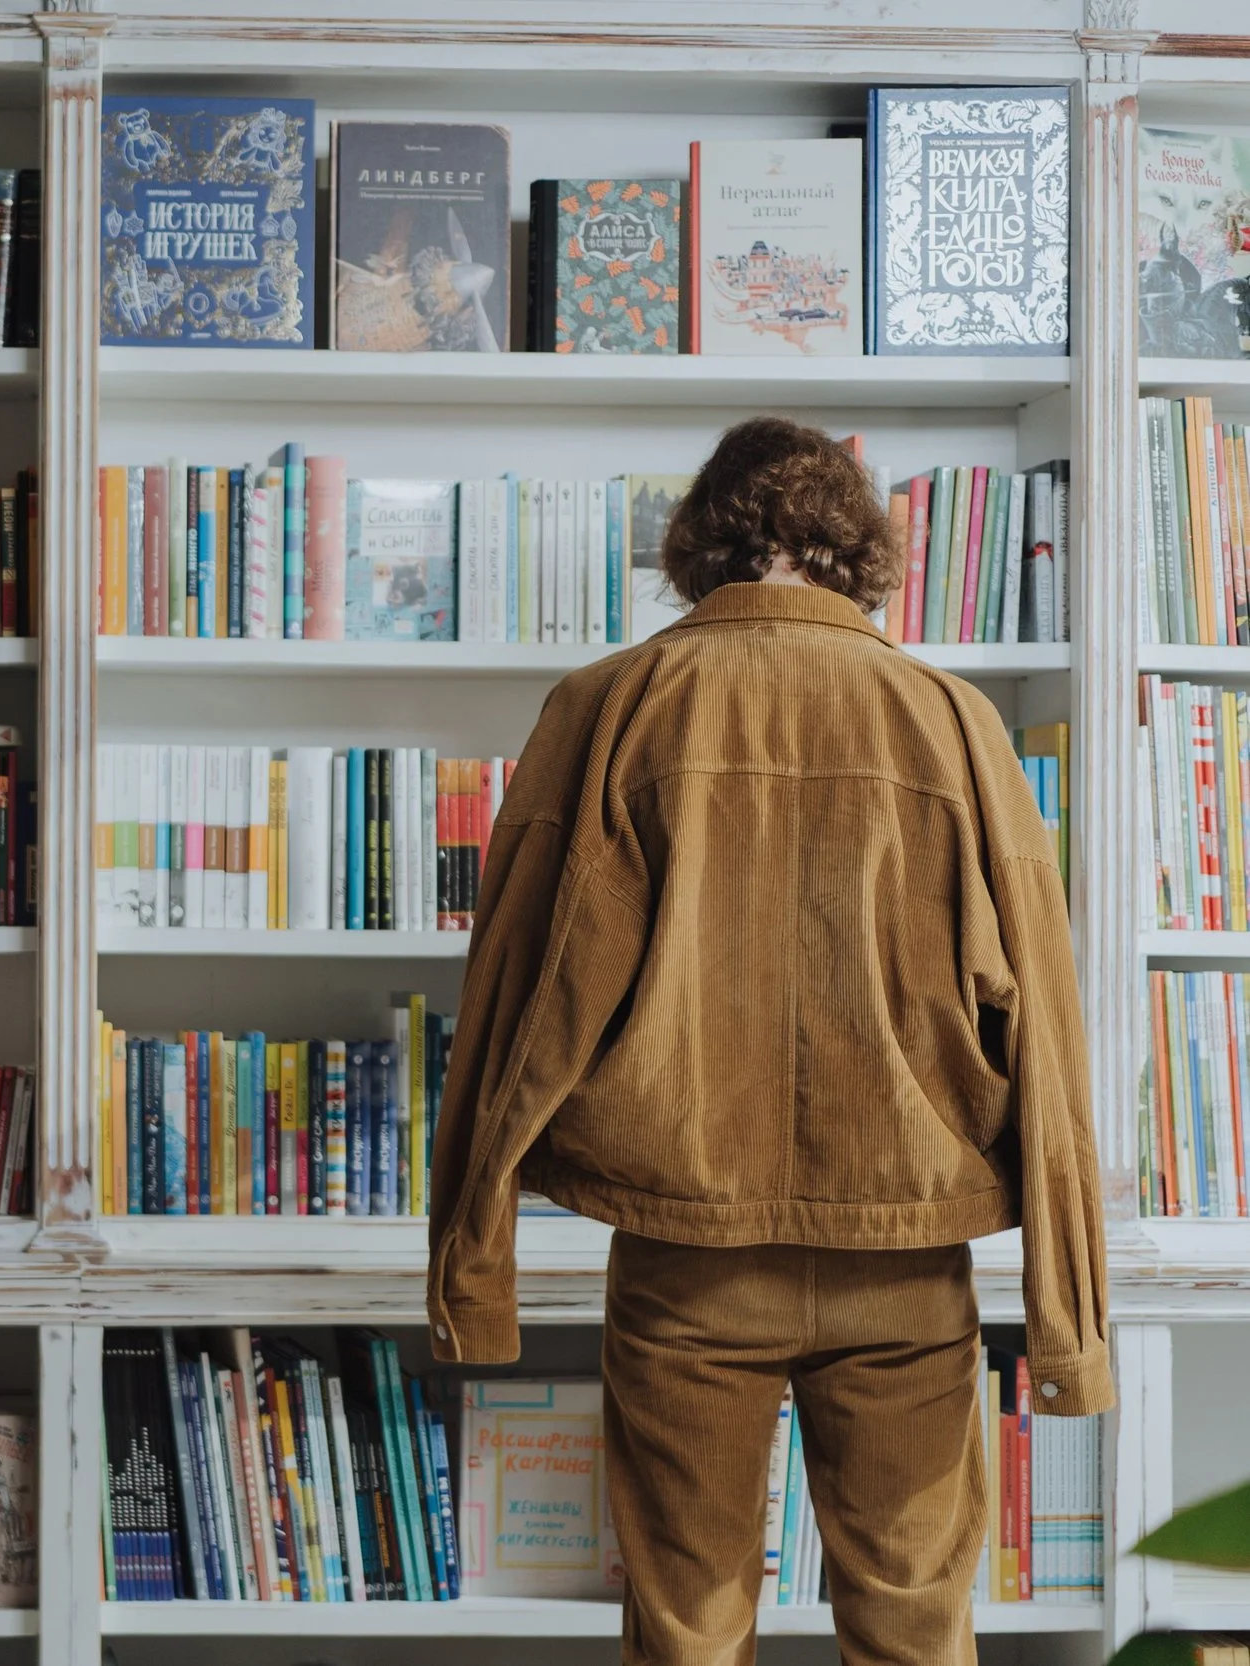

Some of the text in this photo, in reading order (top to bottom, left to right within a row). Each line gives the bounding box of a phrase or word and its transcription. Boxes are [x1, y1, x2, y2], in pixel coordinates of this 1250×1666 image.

[928, 147, 1026, 177] ВЕЛИКАЯ
[358, 169, 486, 186] ЛИНДБЕРГ
[721, 182, 834, 204] Нереальный
[928, 176, 1027, 215] КНИГА
[149, 202, 255, 230] ИСТОРИЯ
[752, 206, 802, 217] атлас
[589, 224, 646, 238] АЛИСА
[924, 213, 1026, 254] ЕДИНО
[145, 231, 258, 260] ИГРУШЕК
[928, 247, 1025, 287] РОГОВ
[3, 501, 14, 532] МОЭМ
[368, 507, 443, 523] СПАСИТЕЛЬ
[381, 534, 415, 549] СЫН
[508, 1498, 582, 1517] ЖЕНЩИНЫ
